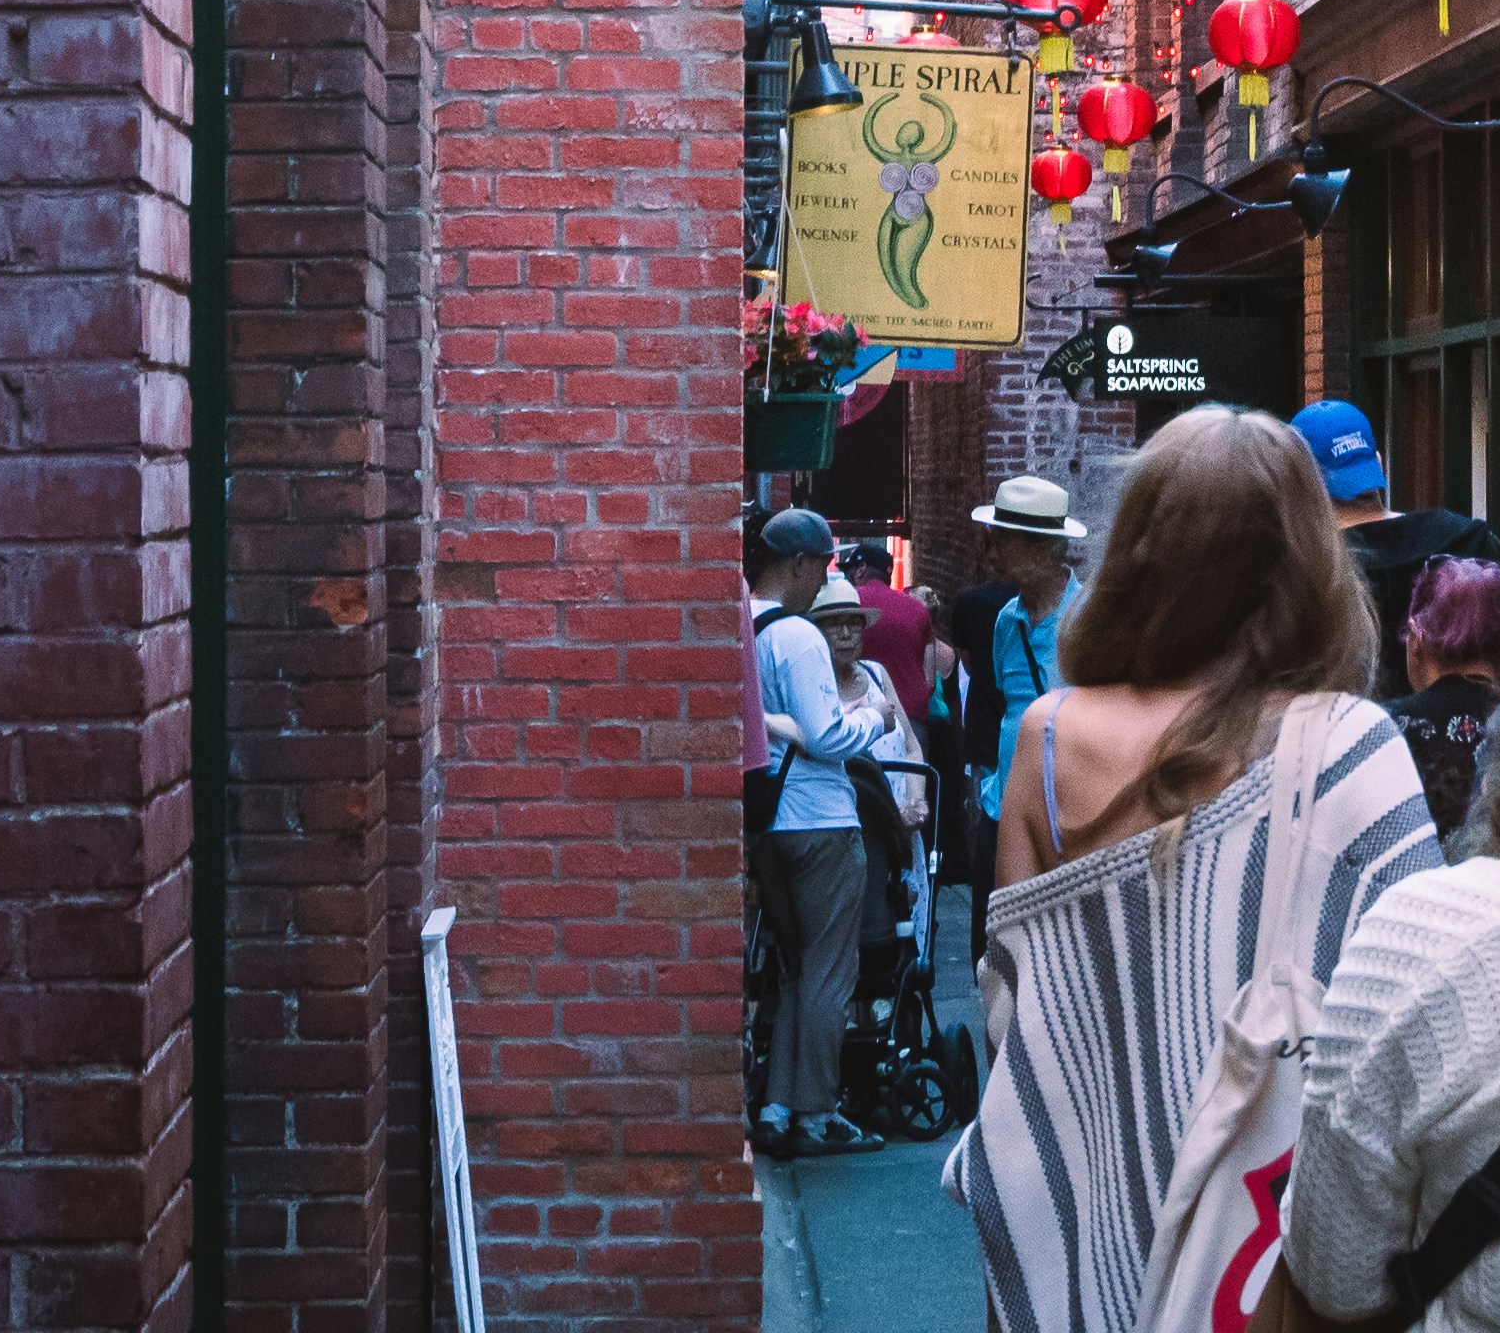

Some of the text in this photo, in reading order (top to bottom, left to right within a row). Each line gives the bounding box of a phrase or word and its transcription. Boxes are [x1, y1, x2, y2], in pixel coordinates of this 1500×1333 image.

[838, 59, 1021, 96] IPLE SPIRAL
[798, 160, 847, 175] BOOKS
[950, 168, 1019, 184] CANDLES
[794, 193, 860, 211] JEWELRY
[967, 202, 1017, 218] TAROT
[797, 227, 859, 243] INCENSE
[941, 234, 1017, 250] CRYSTALS
[1107, 358, 1199, 373] SALTSPRING
[1107, 377, 1205, 391] SOAPWORKS
